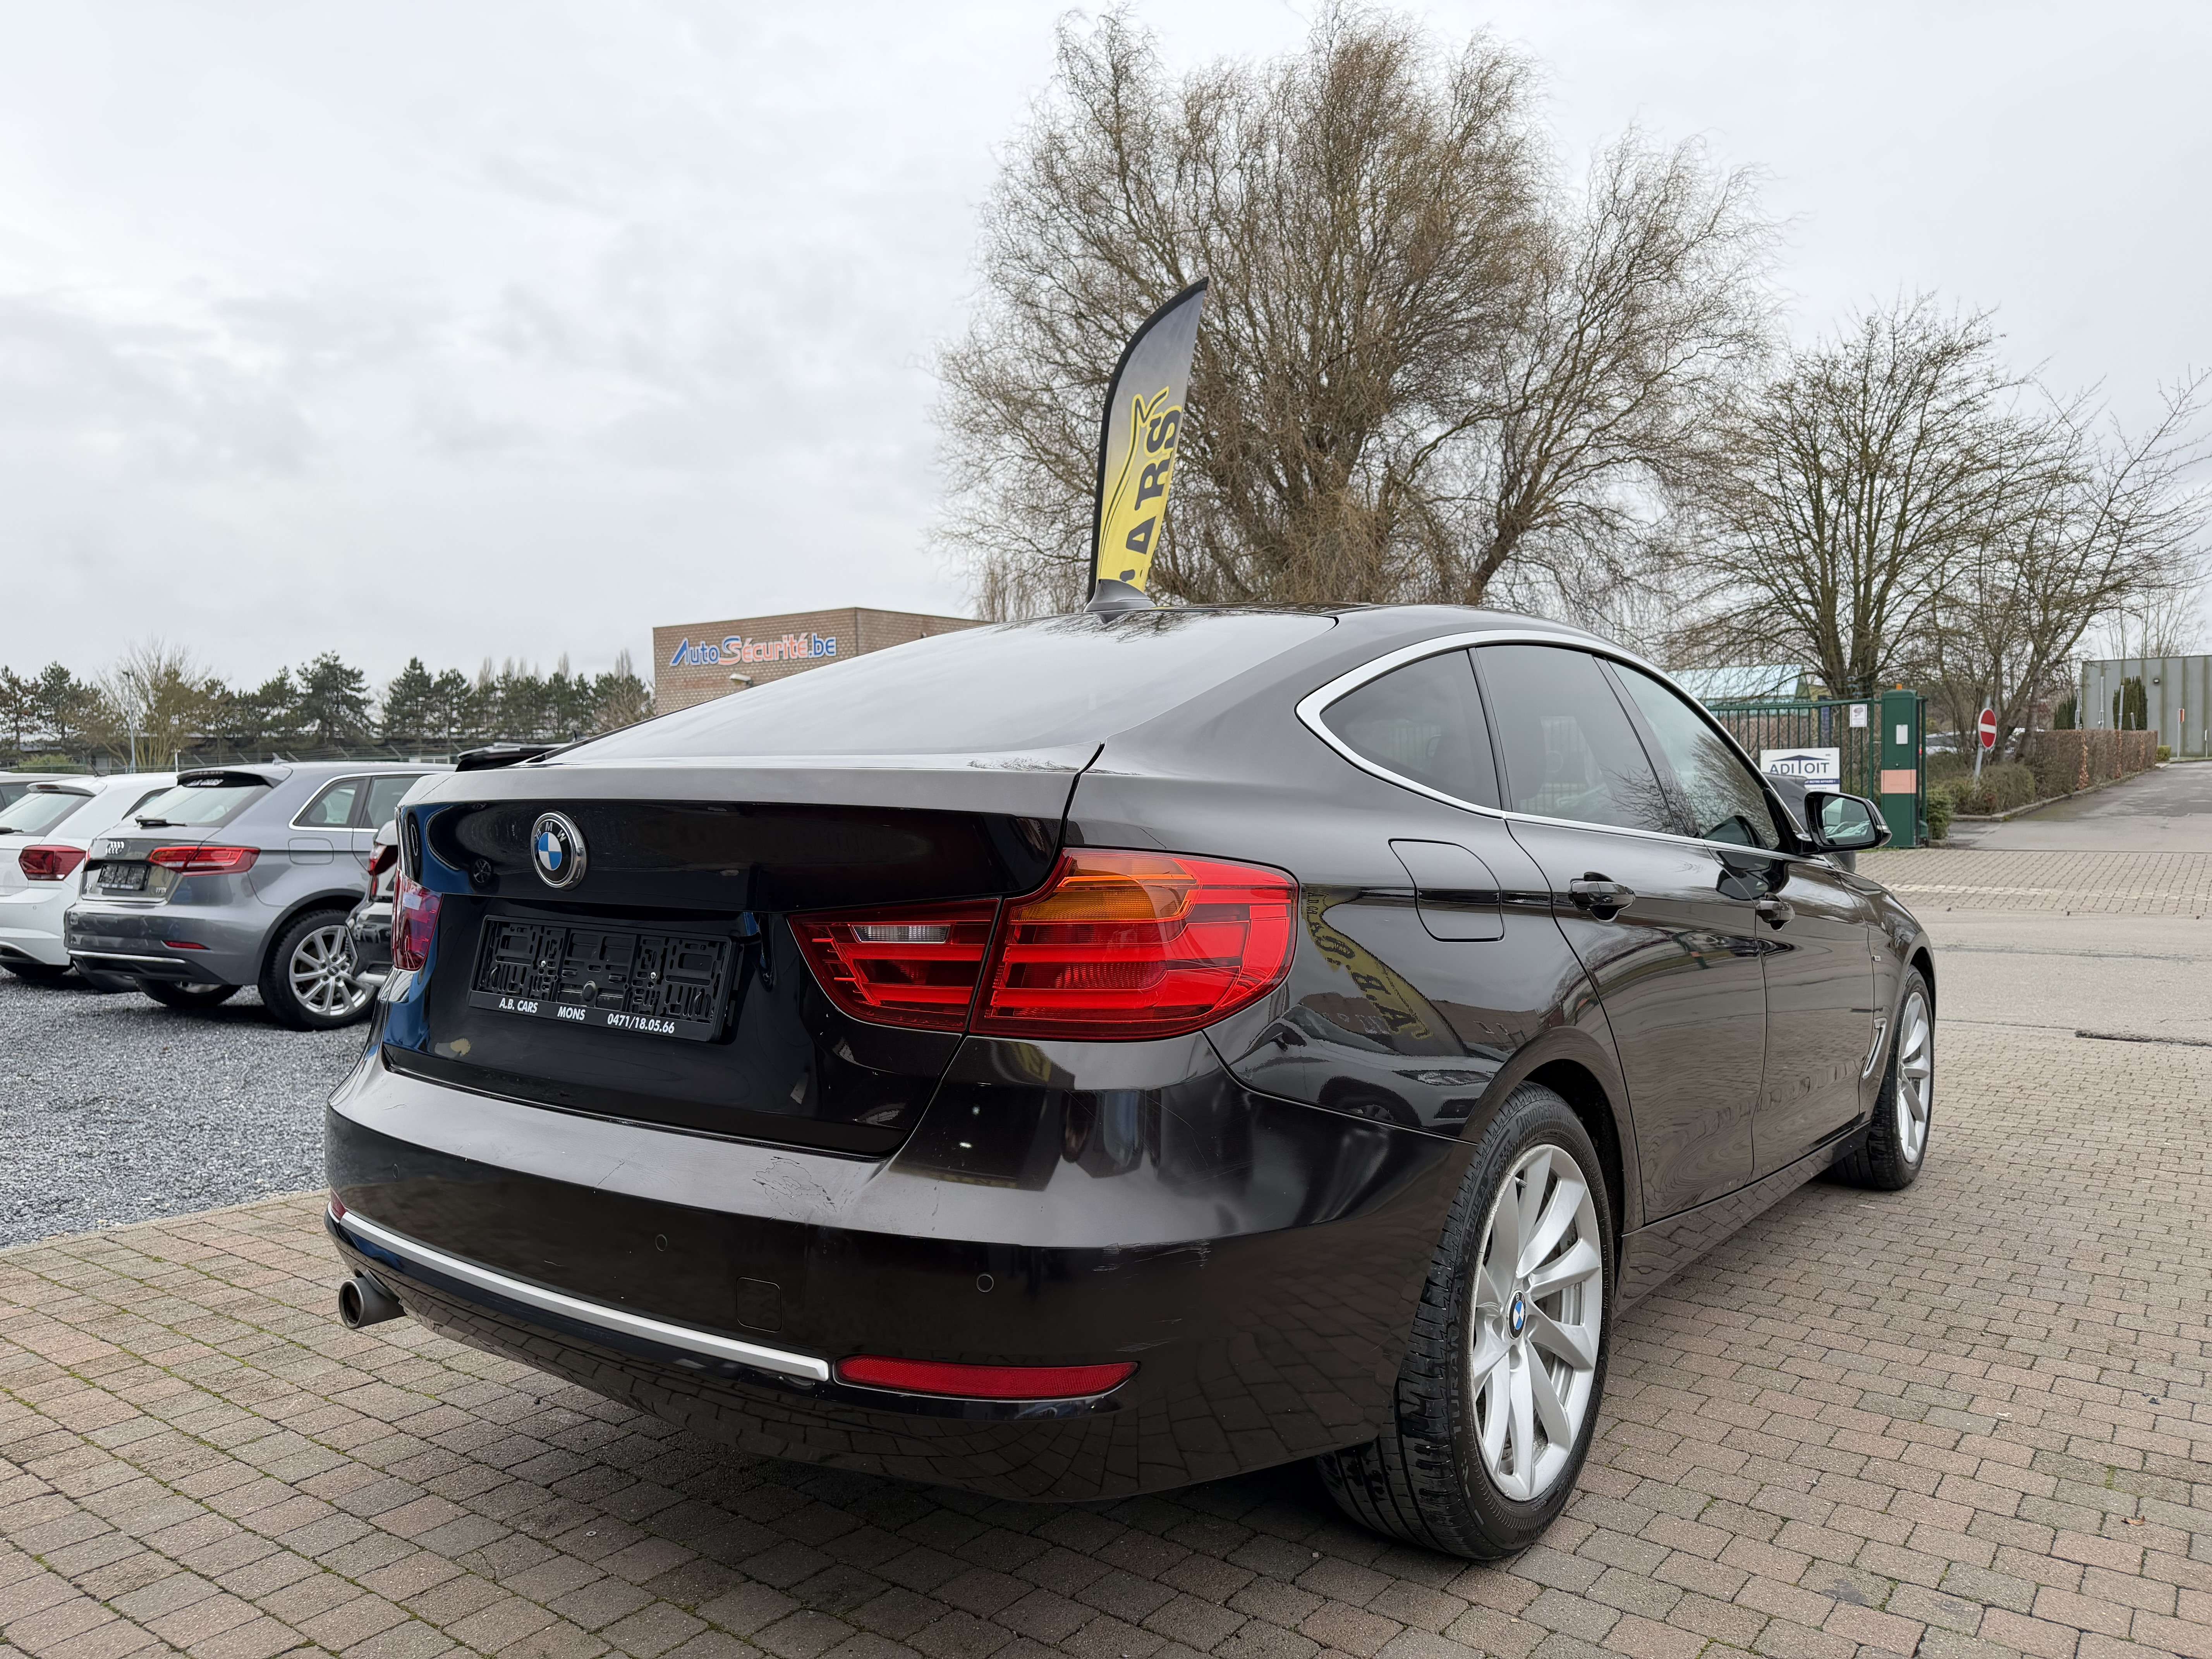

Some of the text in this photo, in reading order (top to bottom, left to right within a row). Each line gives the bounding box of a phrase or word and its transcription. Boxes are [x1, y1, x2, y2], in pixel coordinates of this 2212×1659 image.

[1119, 406, 1182, 582] ARS
[670, 633, 836, 666] AutoSécurité.be
[534, 821, 567, 842] BMW
[499, 998, 675, 1034] A.B. CARS MONS 0471/18.05.66
